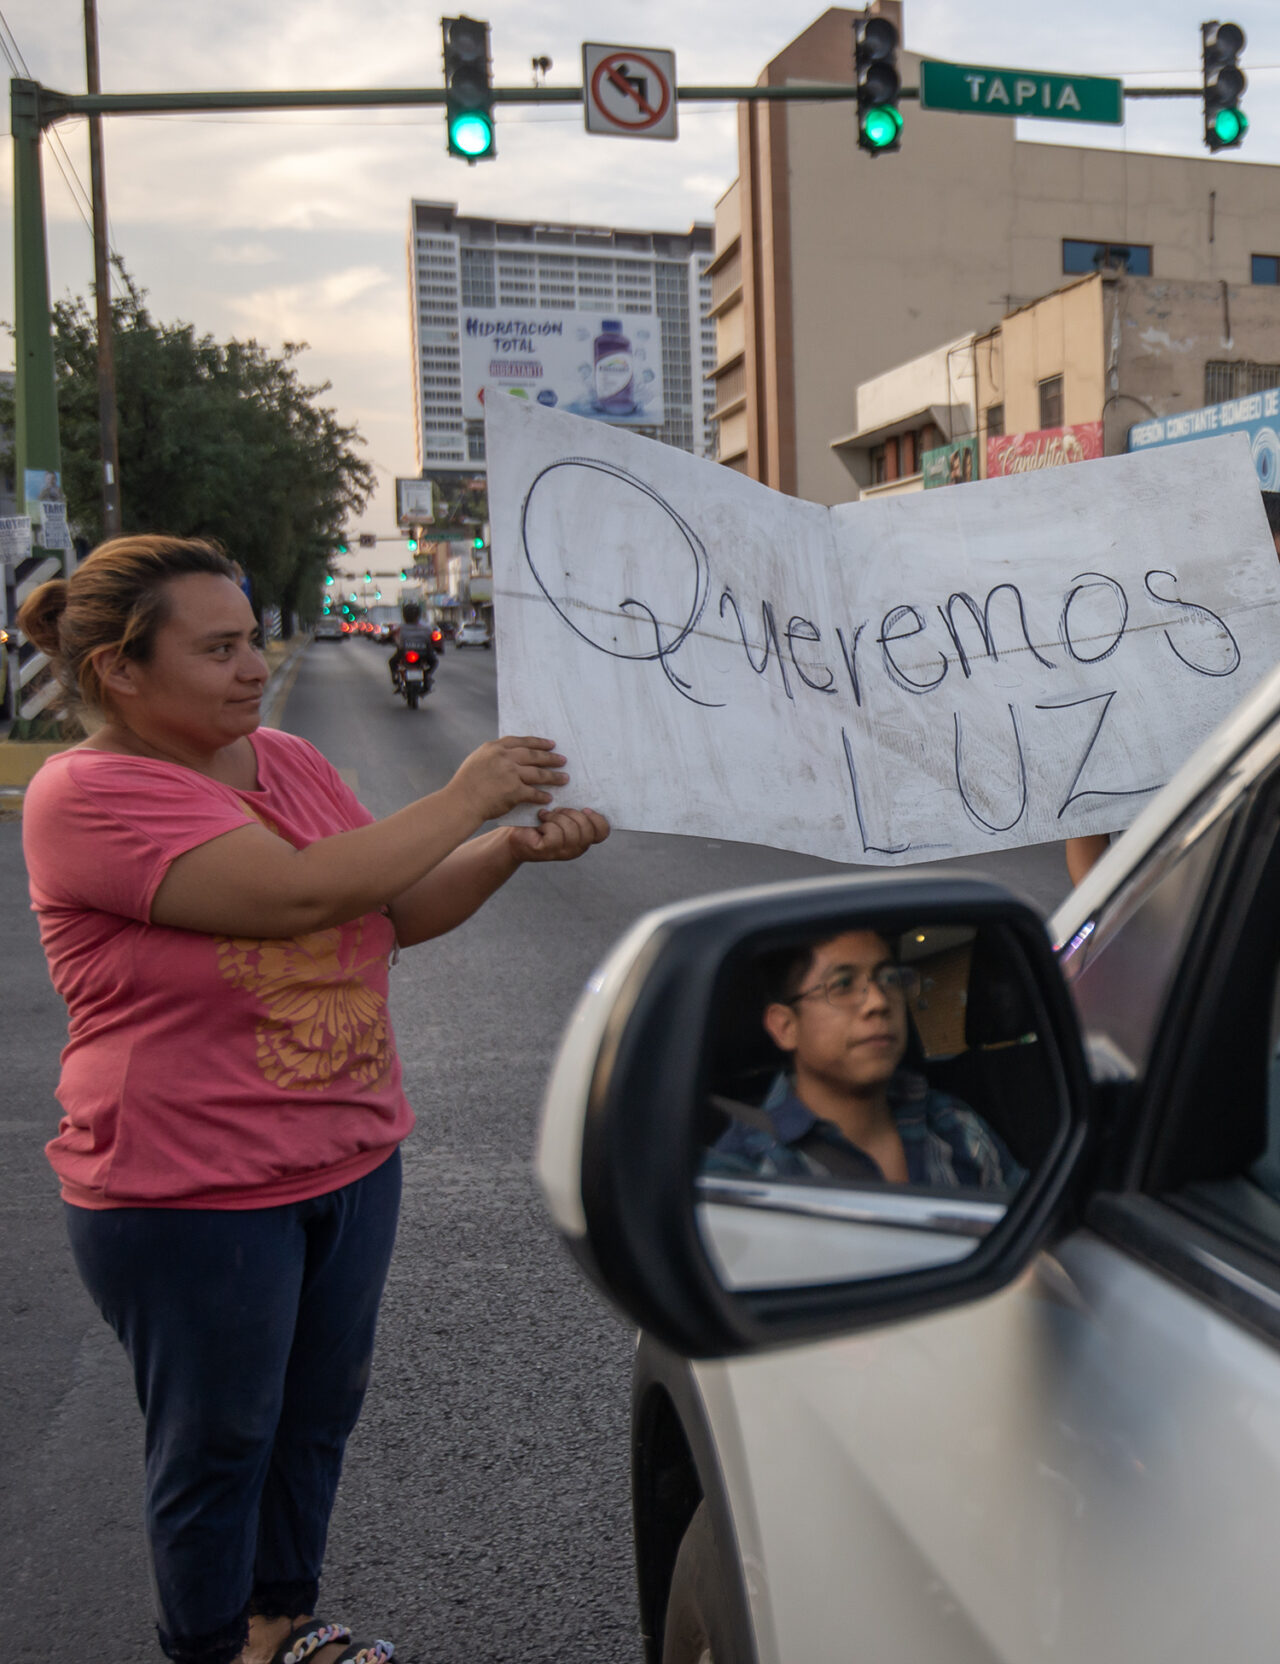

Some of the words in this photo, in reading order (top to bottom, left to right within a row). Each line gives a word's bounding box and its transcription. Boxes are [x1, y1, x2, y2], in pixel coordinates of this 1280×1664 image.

[964, 74, 1081, 112] TAPIA
[466, 317, 563, 337] HIDRATACIÓN
[493, 338, 536, 353] TOTAL
[1132, 421, 1165, 447] PRESIÓN
[1264, 391, 1279, 418] DE
[523, 455, 1242, 707] Queremos
[841, 690, 1173, 853] LUZ
